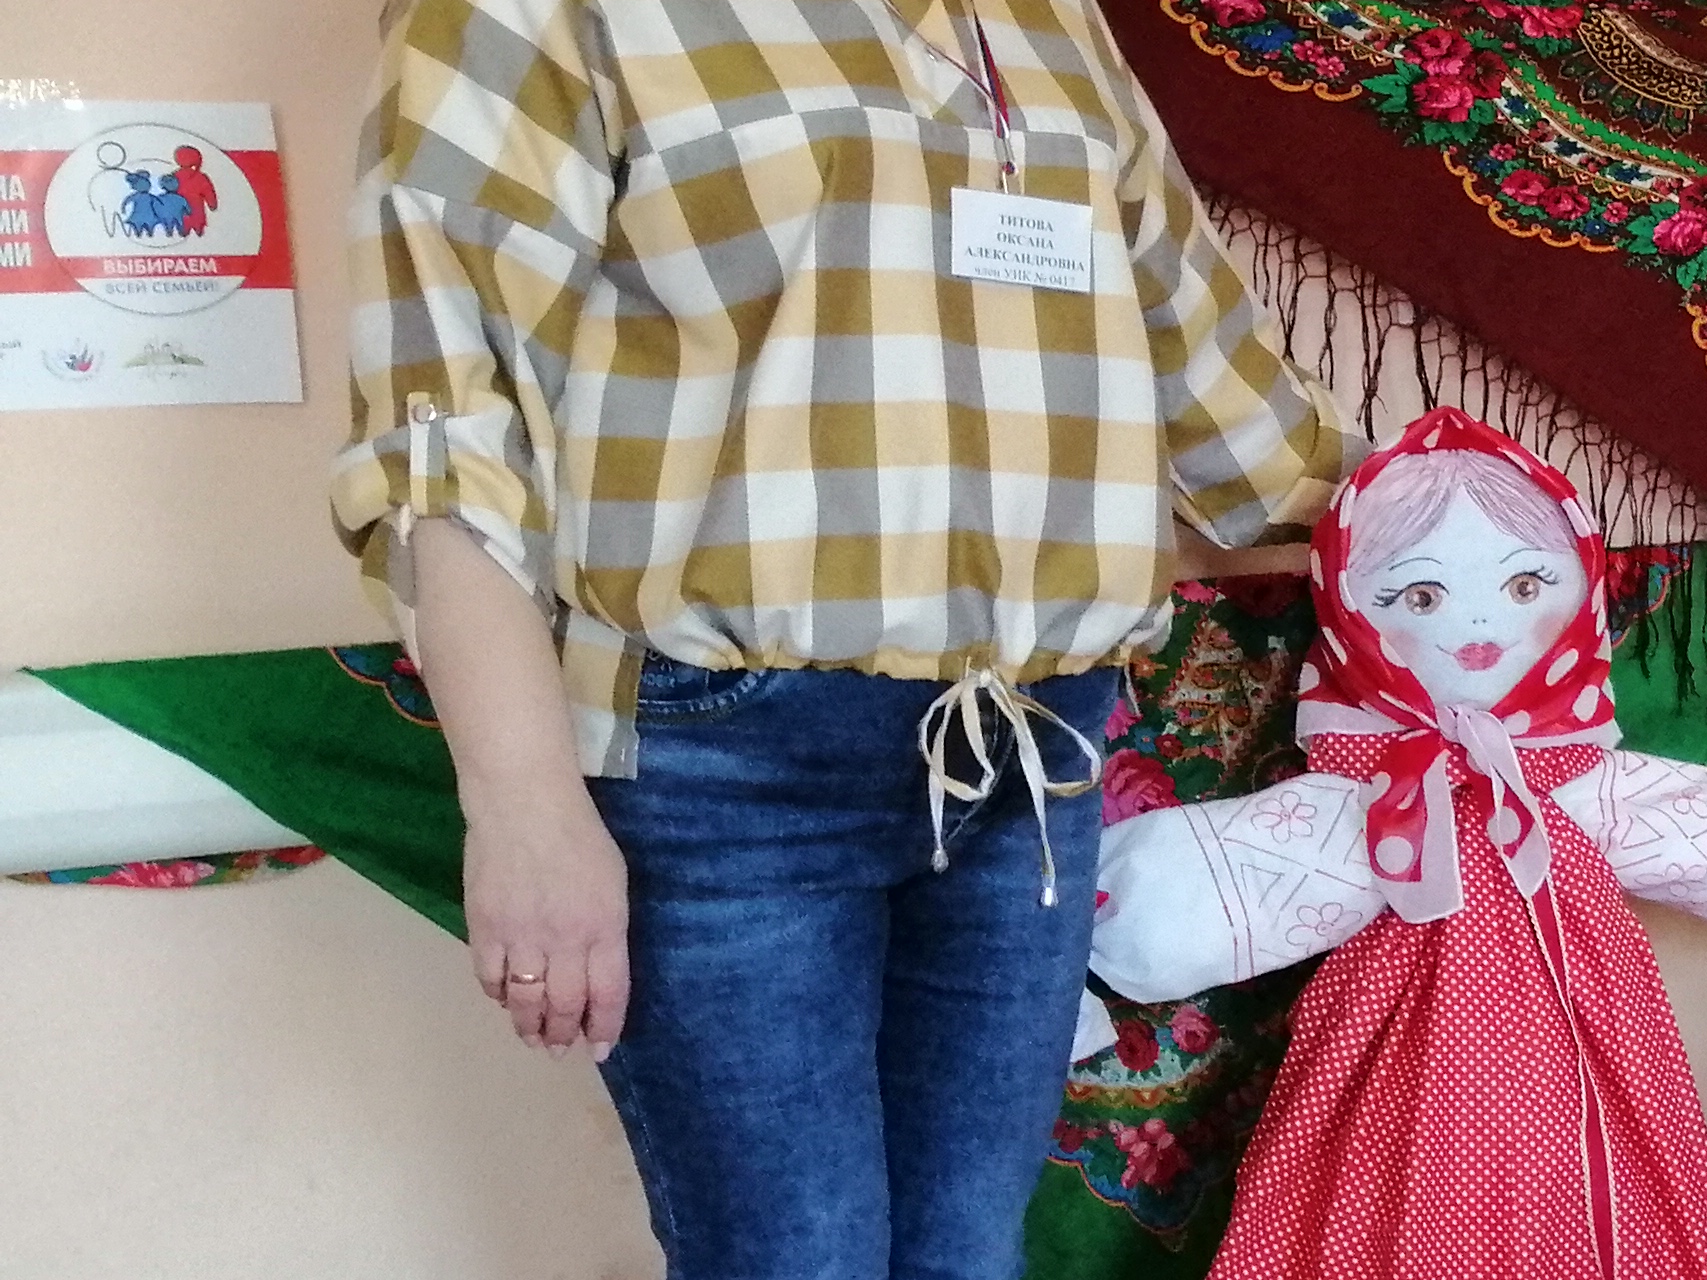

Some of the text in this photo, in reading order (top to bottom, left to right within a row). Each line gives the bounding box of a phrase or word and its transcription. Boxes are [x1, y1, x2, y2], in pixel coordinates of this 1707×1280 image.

[1000, 214, 1054, 232] ТИТОВА
[997, 232, 1054, 250] ОКСАНА
[103, 258, 217, 275] ВЫБИРАЕМ
[965, 247, 1085, 271] АЛЕКСАНДРОВНА
[105, 281, 148, 295] ВСЕЙ
